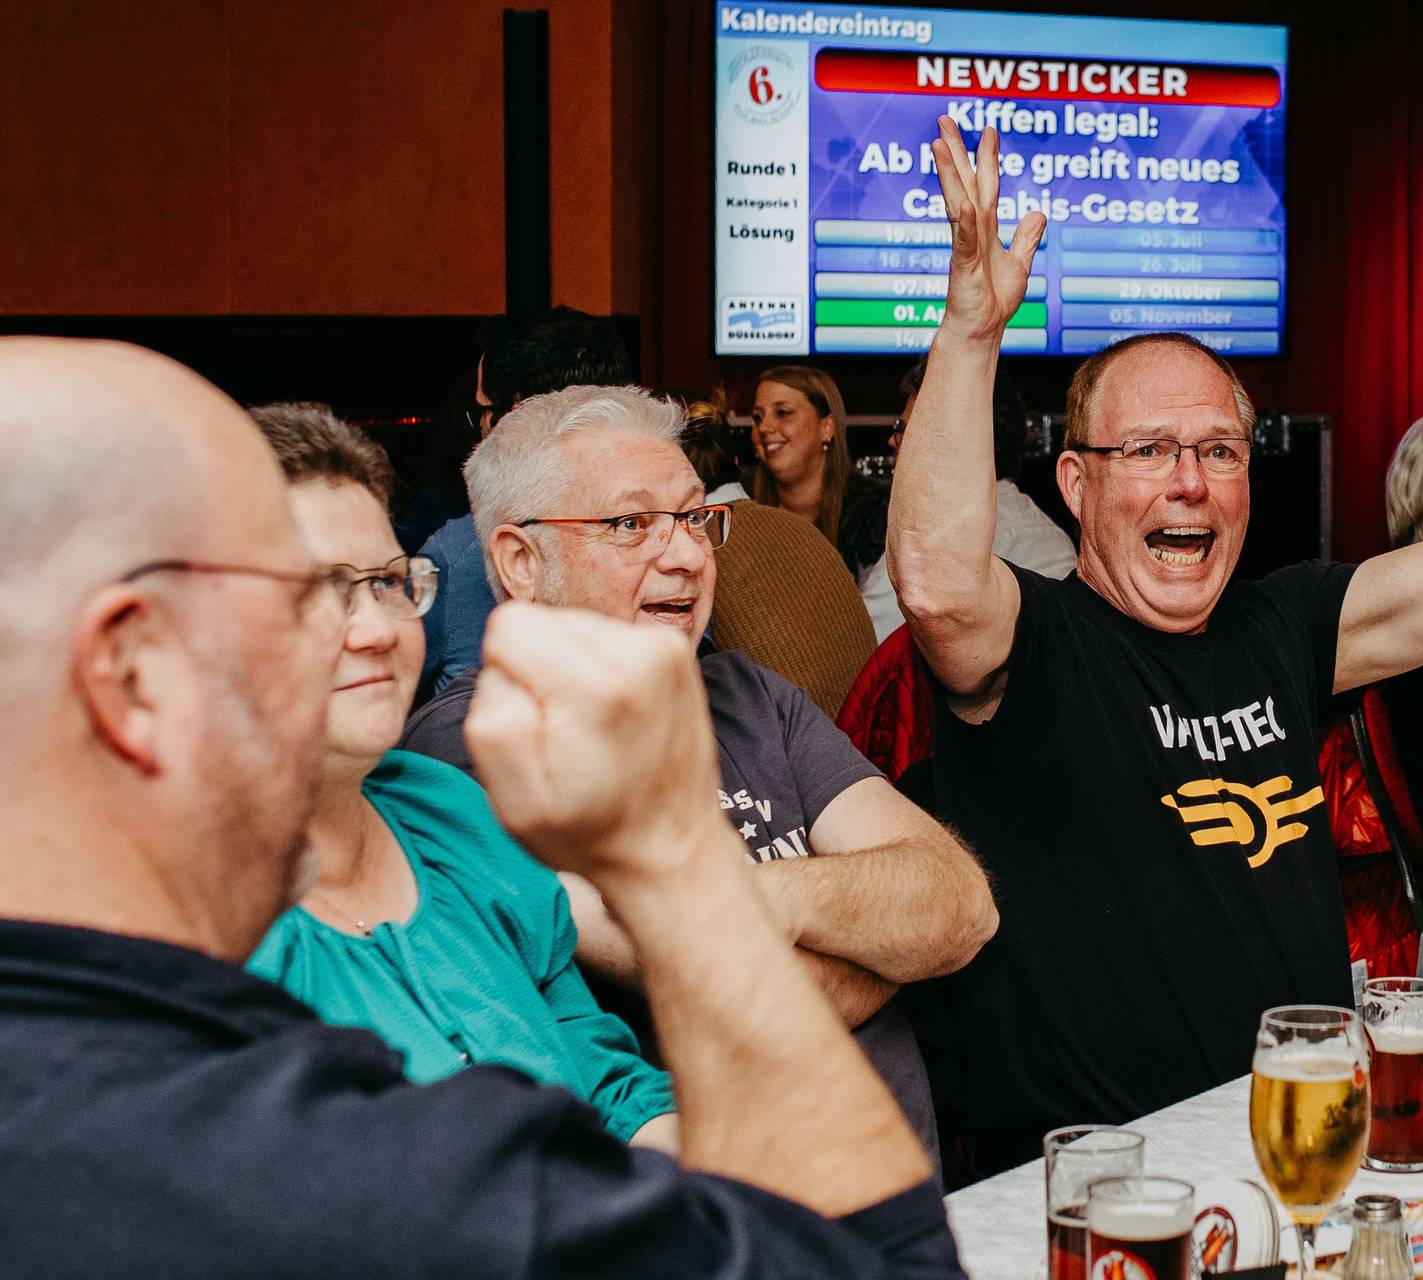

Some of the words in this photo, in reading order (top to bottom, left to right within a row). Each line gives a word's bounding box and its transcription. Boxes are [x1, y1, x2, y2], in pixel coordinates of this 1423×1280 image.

[720, 7, 933, 44] Kalendereintrag
[749, 66, 783, 106] 6.
[917, 56, 1188, 97] NEWSTICKER
[947, 99, 1058, 135] Kiffen
[1064, 103, 1159, 143] legal:
[727, 161, 786, 176] Runde
[791, 162, 797, 176] 1
[858, 142, 914, 174] Ab
[1030, 146, 1131, 185] greift
[1136, 156, 1240, 184] neues
[726, 197, 790, 210] Kategorie
[902, 187, 1200, 225] Caabis-Gesetz
[729, 224, 795, 243] Lösung
[1150, 282, 1223, 301] Oktober
[893, 304, 920, 321] 01.
[1140, 307, 1234, 326] November
